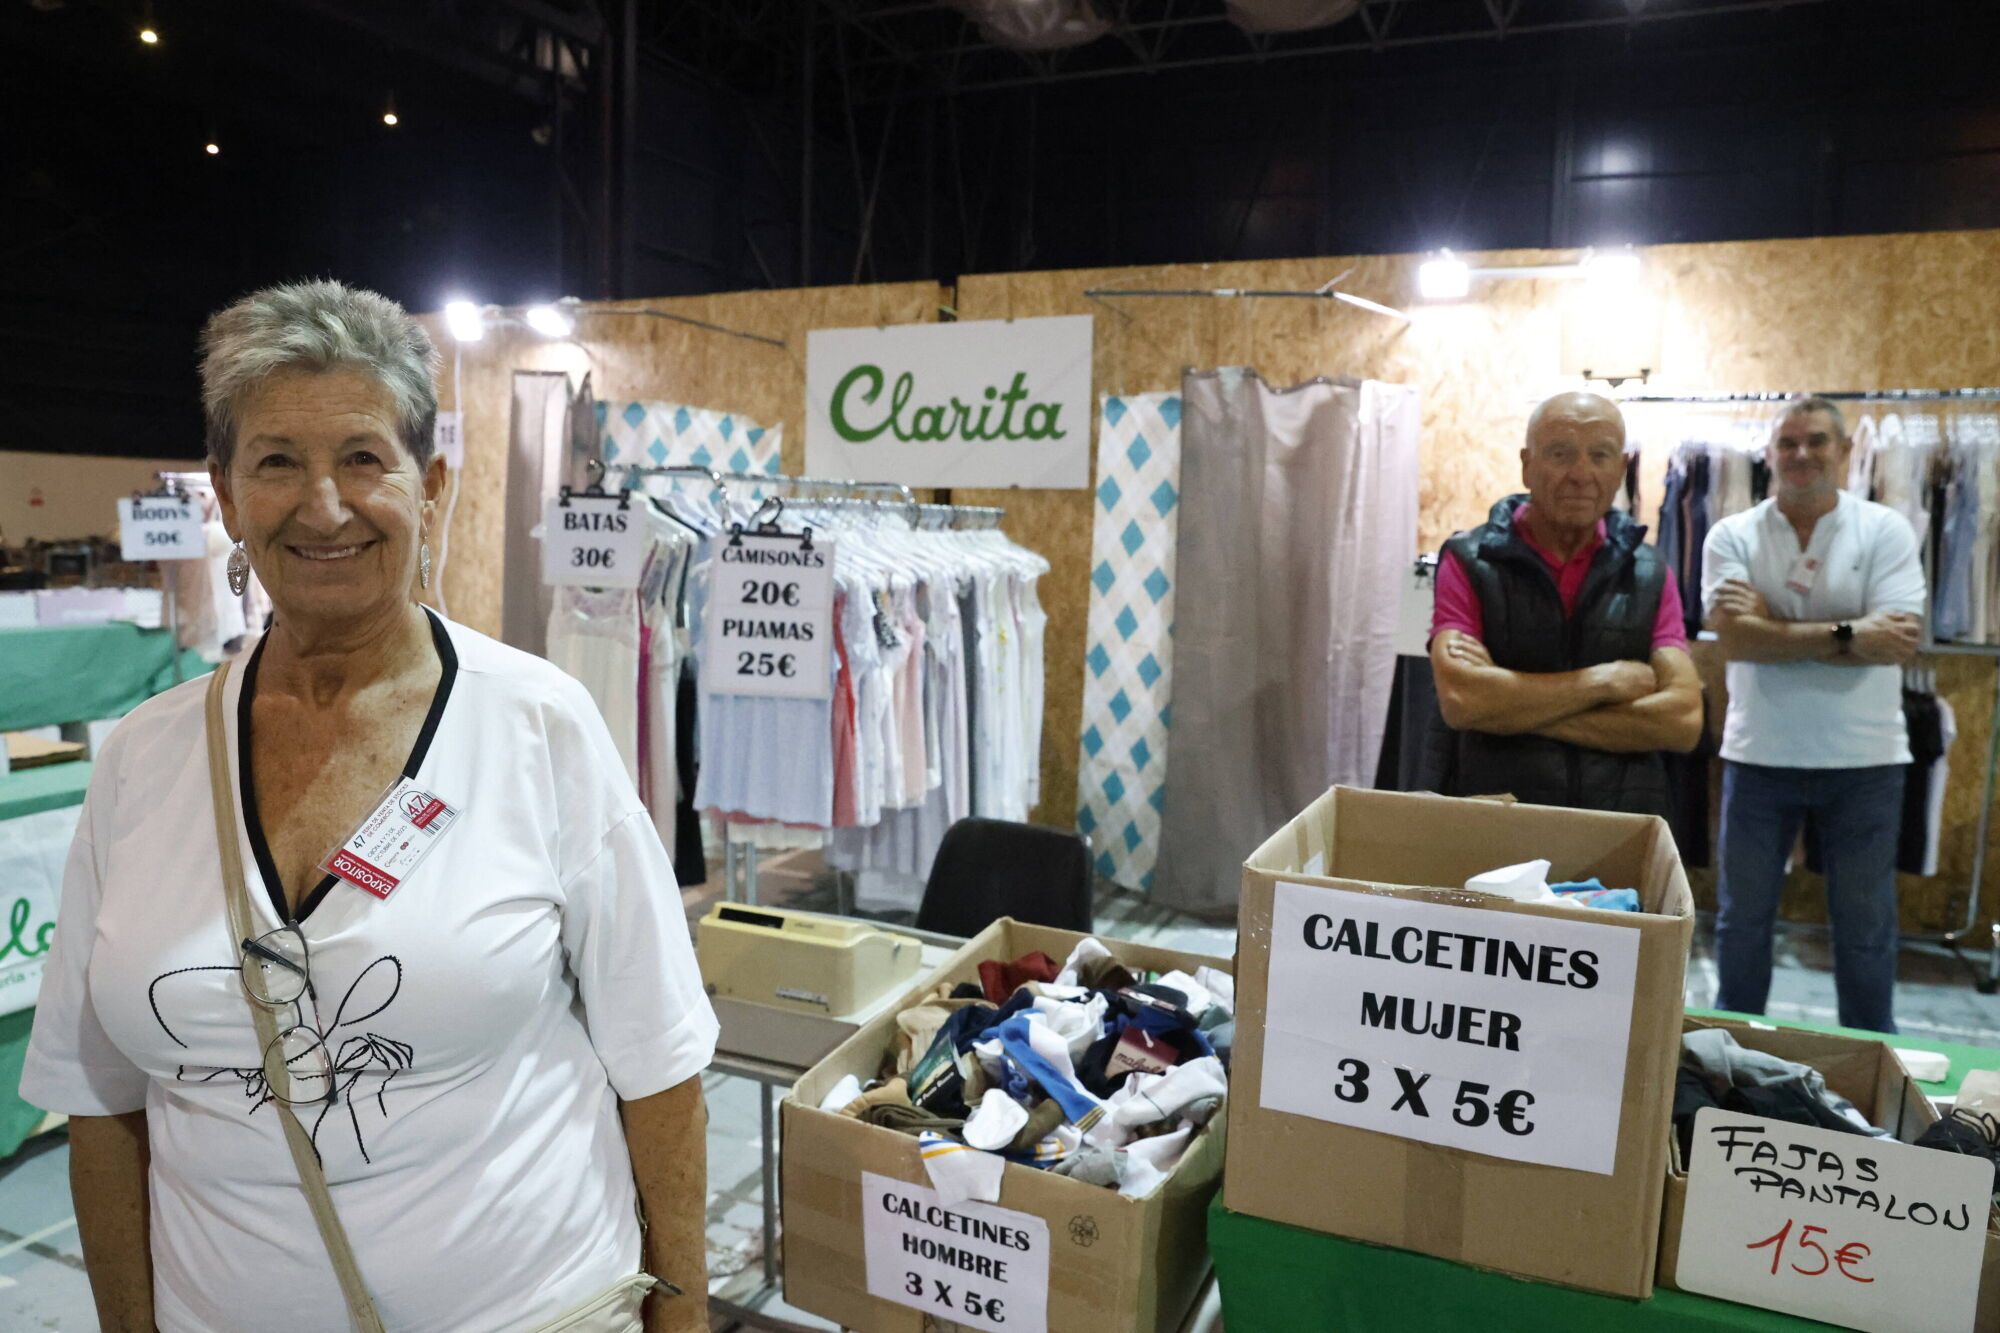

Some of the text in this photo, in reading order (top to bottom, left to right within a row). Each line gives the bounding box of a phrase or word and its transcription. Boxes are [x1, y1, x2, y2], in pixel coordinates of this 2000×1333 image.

[830, 364, 1067, 443] Clarita
[564, 512, 629, 533] BATAS
[571, 547, 616, 569] 30€
[721, 548, 825, 568] CAMISONES
[741, 580, 800, 607] 20€
[722, 619, 814, 641] PIJAMAS
[737, 651, 797, 678] 25€
[407, 795, 427, 816] 47
[353, 835, 366, 849] 47
[333, 857, 393, 895] EXPOSITOR
[1303, 913, 1599, 989] CALCETINES
[1360, 991, 1521, 1052] MUJER
[1334, 1058, 1535, 1136] 3 X 5€
[1711, 1126, 1879, 1182] FAJAS
[882, 1193, 1031, 1251] CALCETINES
[1734, 1167, 1970, 1231] PANTALON
[902, 1232, 1008, 1283] HOMBRE
[1746, 1219, 1874, 1283] 15€
[905, 1272, 1005, 1323] 3 X 5€
